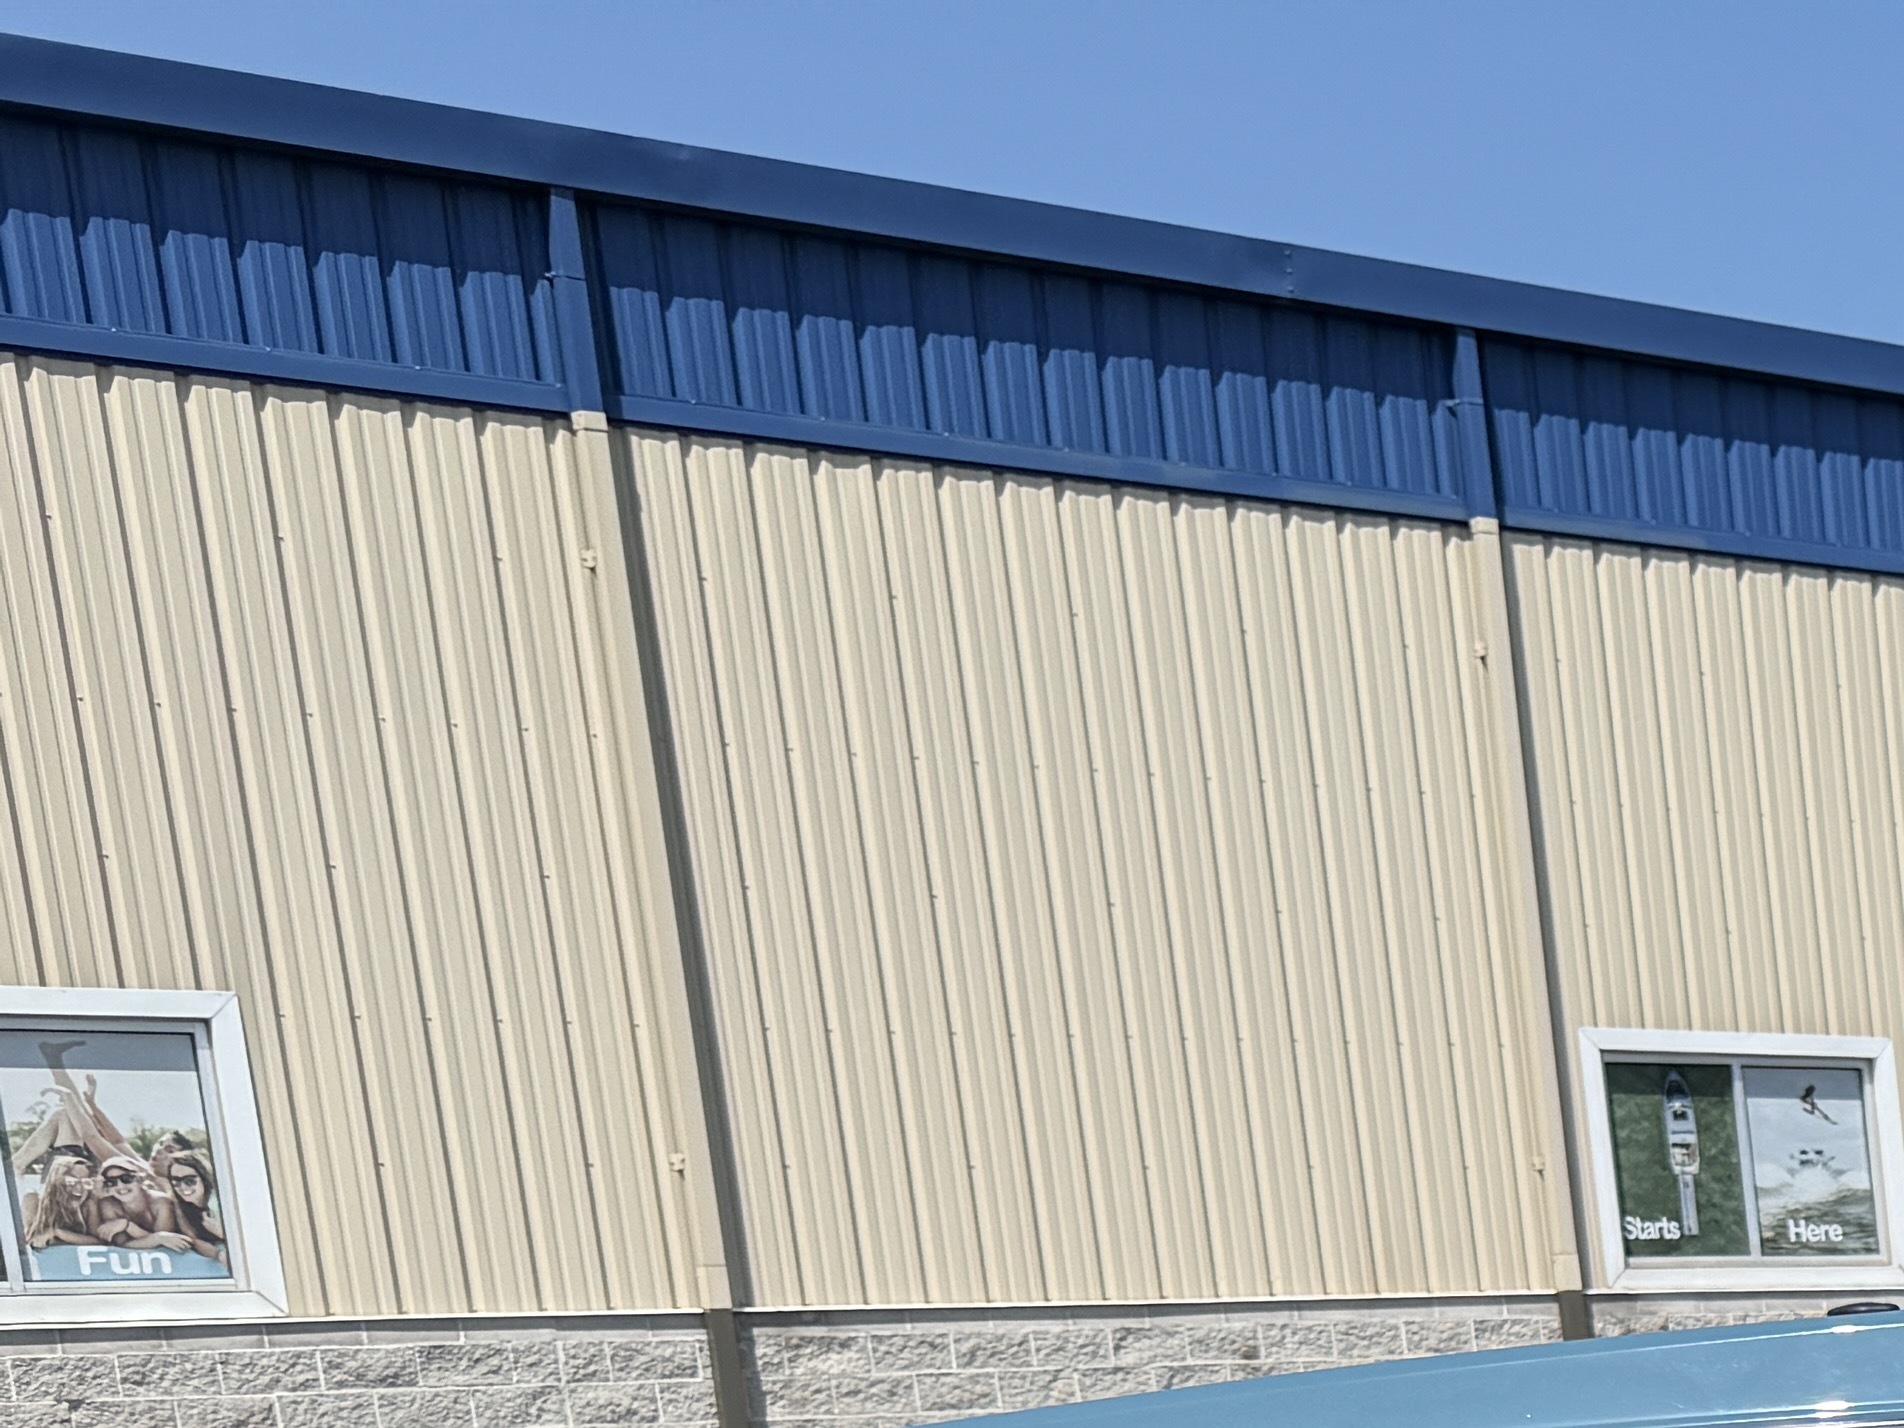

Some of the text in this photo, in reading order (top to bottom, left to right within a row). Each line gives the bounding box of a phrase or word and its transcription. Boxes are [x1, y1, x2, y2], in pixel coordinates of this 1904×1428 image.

[1624, 1216, 1681, 1240] Starts
[1789, 1218, 1843, 1242] Here
[76, 1246, 173, 1276] Fun
